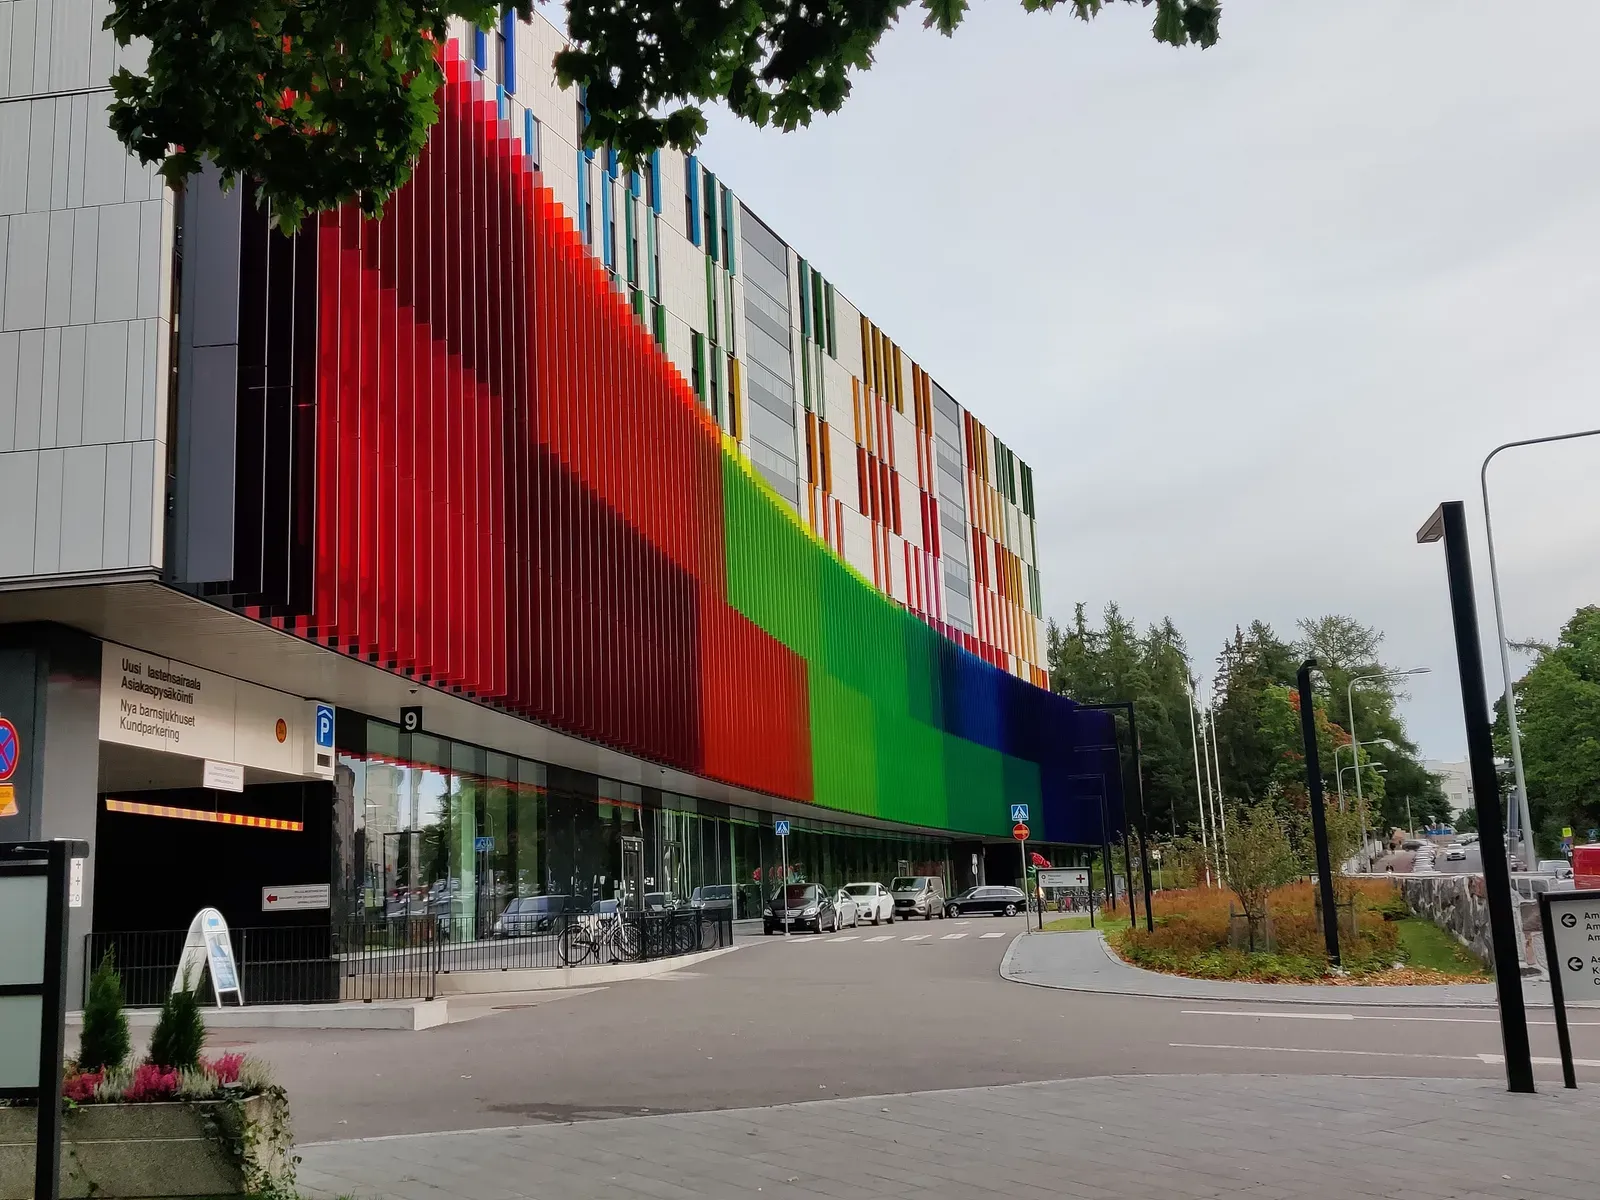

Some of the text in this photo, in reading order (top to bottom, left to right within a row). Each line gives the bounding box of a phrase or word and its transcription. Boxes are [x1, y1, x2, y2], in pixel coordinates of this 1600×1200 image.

[122, 658, 201, 690] Uusi lastensairaala
[121, 676, 194, 704] Asiakaspysäköinti
[120, 699, 195, 727] Nya barnsjukhuset
[405, 711, 417, 730] 9
[119, 716, 180, 743] Kundparkering
[320, 717, 330, 743] P
